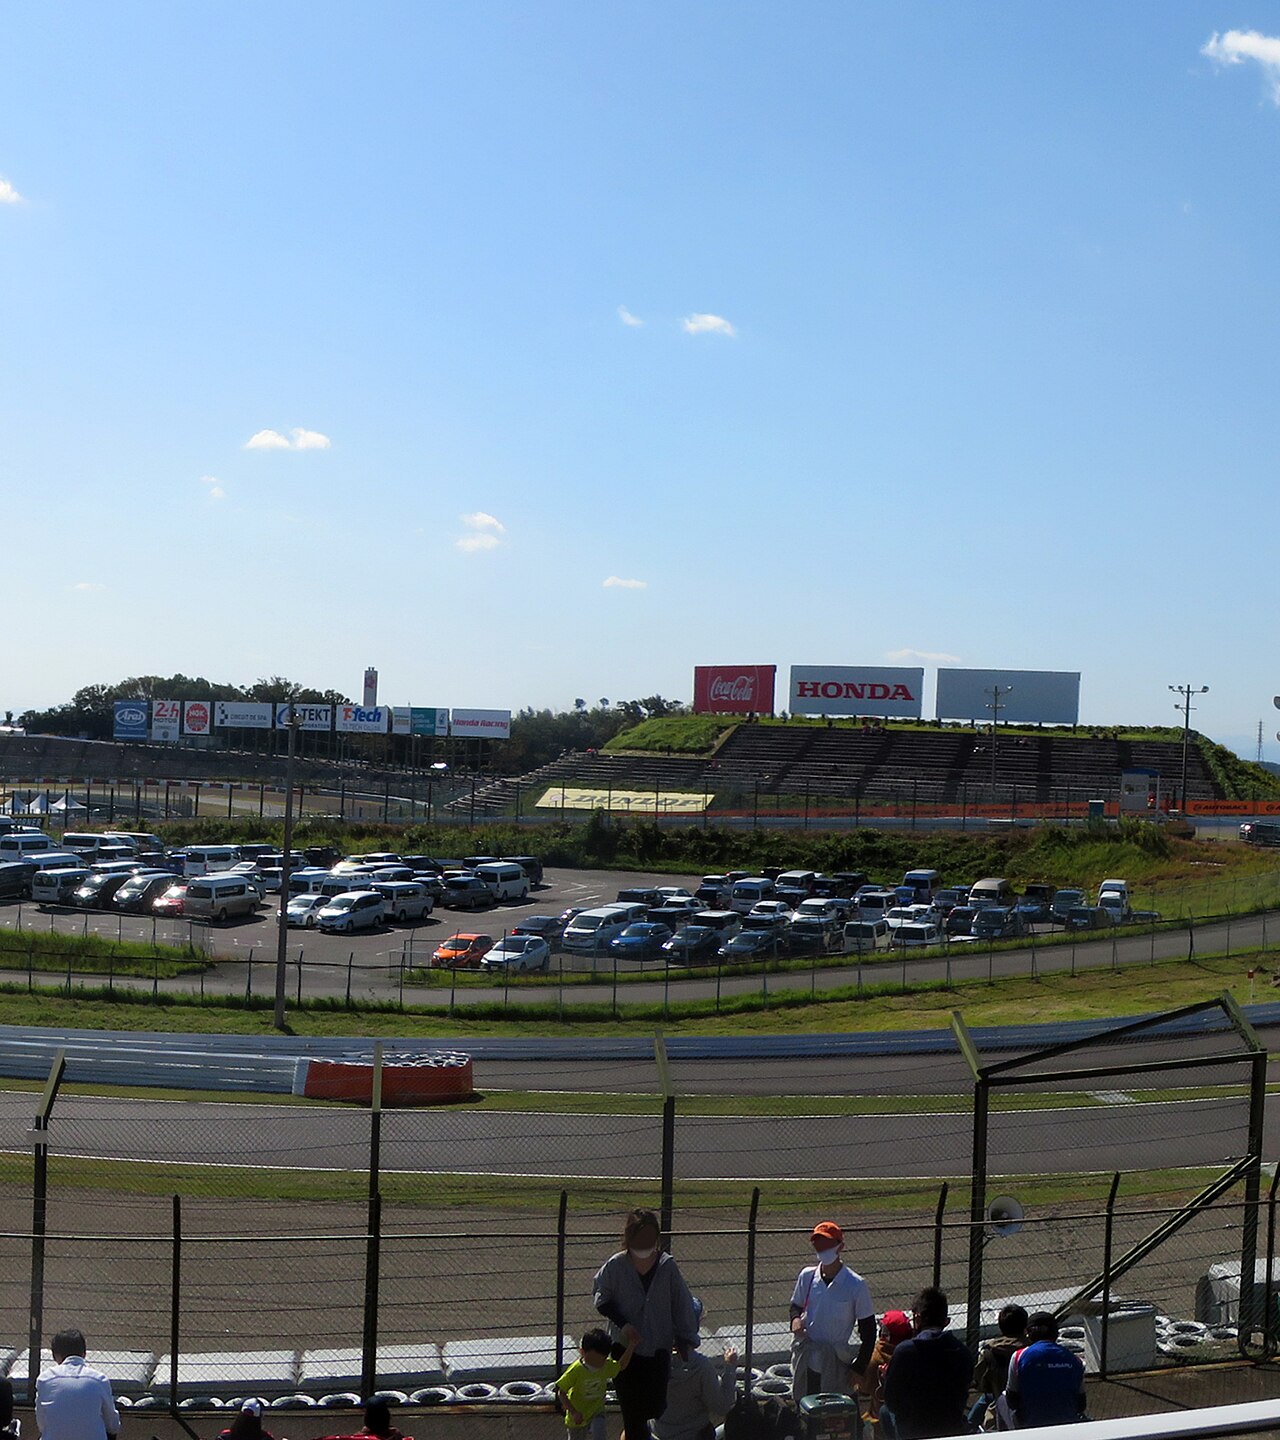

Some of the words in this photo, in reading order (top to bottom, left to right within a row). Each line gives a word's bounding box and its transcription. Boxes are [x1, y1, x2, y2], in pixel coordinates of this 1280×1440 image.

[797, 681, 914, 701] HONDA
[452, 718, 478, 727] Honda
[480, 720, 508, 729] Racing
[1203, 803, 1248, 811] AUTOBACS
